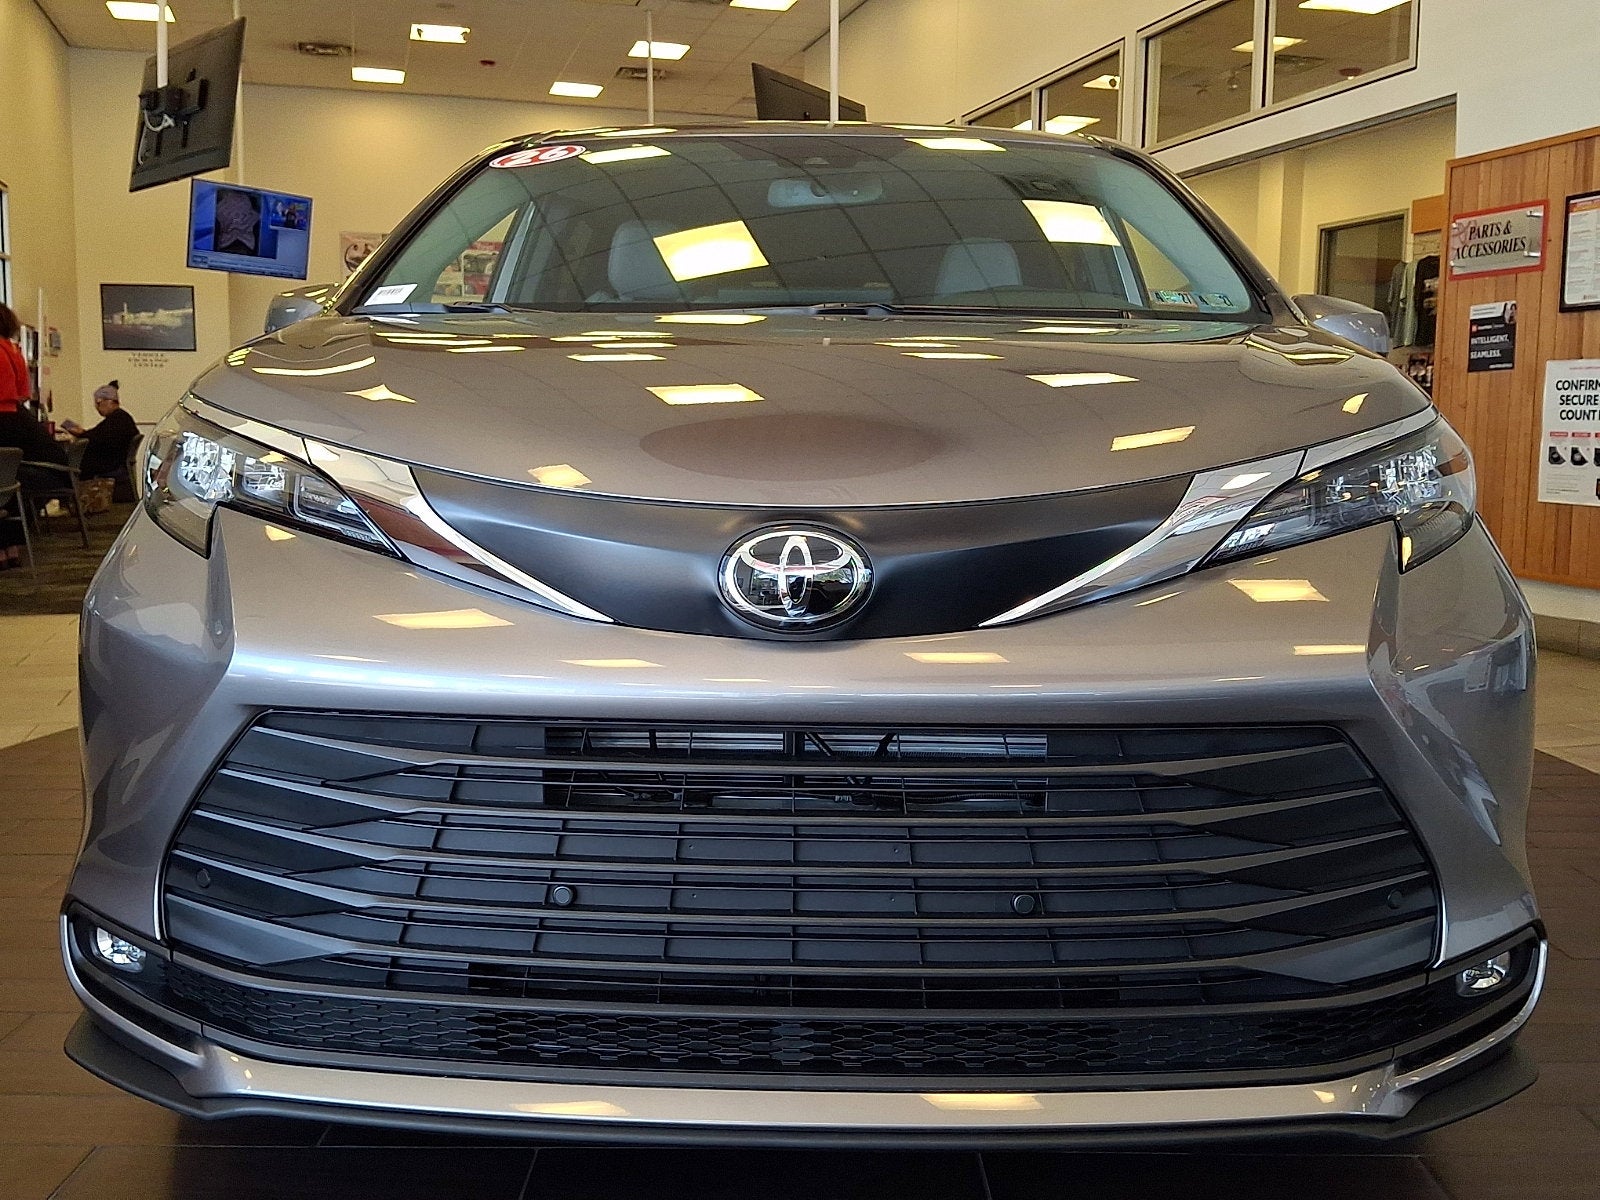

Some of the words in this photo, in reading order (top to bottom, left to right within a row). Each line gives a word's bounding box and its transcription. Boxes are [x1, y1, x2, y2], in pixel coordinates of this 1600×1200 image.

[502, 145, 570, 166] 26
[1469, 222, 1502, 241] PARTS
[1503, 220, 1512, 235] &
[1454, 236, 1527, 260] ACCESSORIES
[1559, 394, 1599, 406] SECURE
[1559, 409, 1600, 421] COUNT
